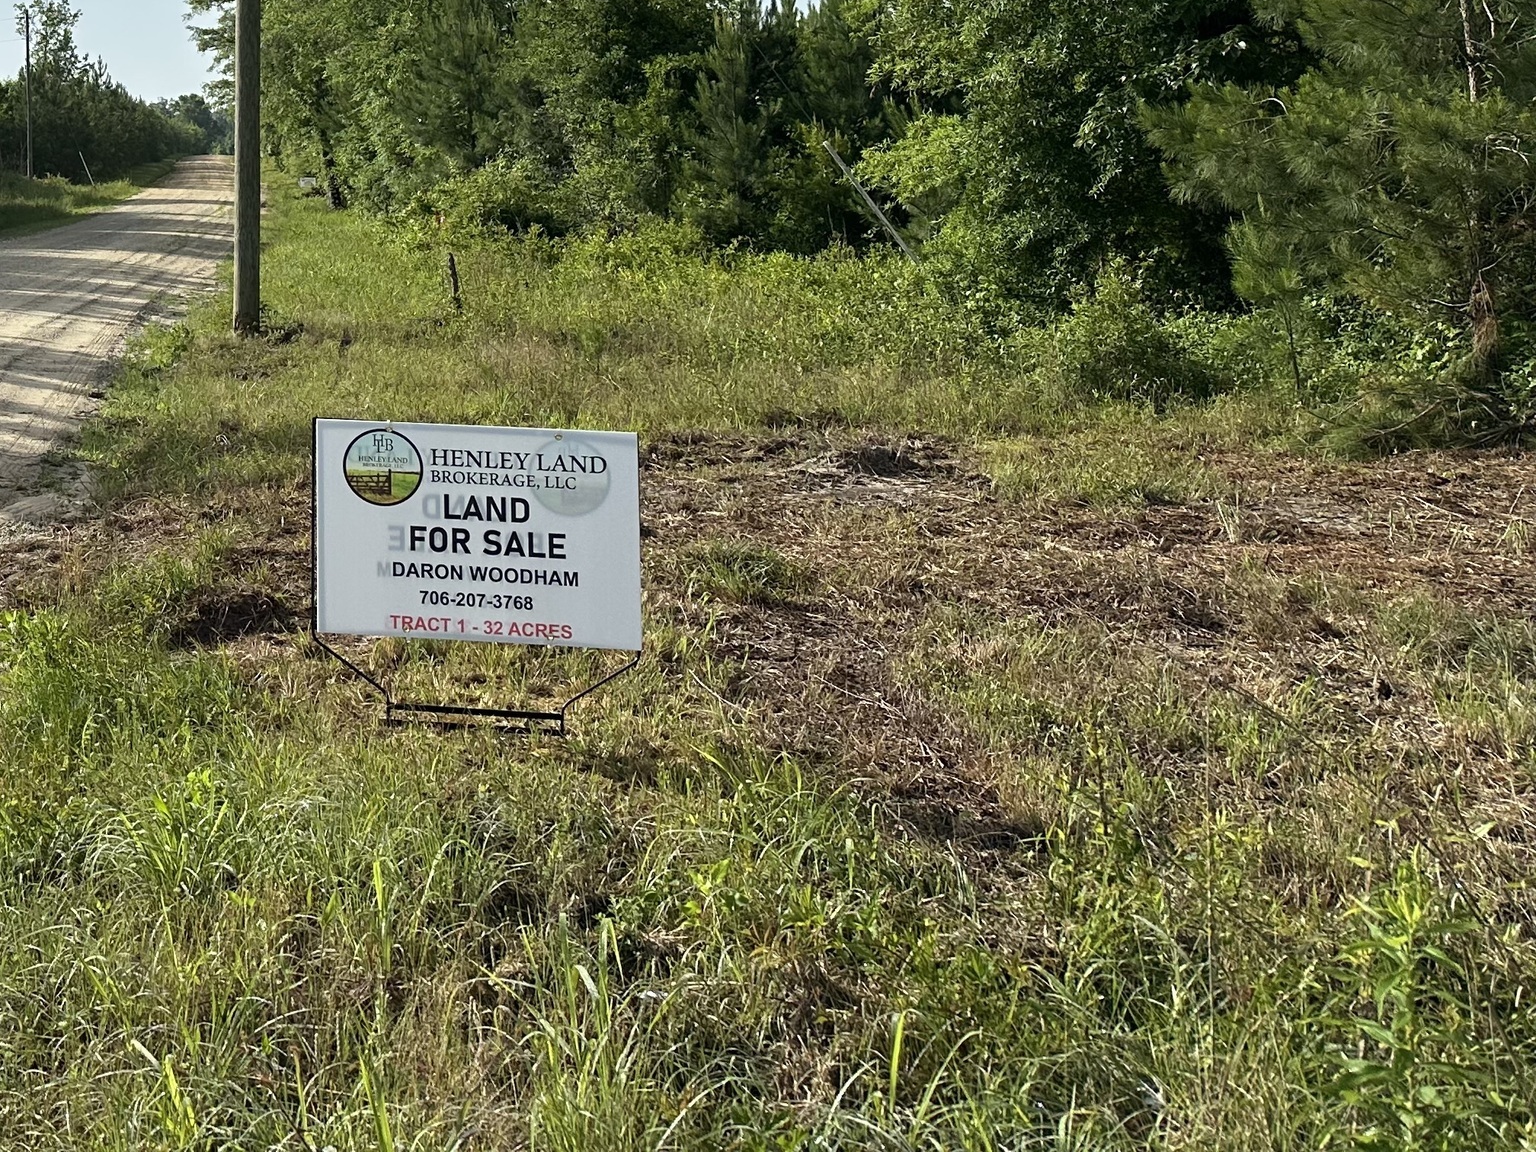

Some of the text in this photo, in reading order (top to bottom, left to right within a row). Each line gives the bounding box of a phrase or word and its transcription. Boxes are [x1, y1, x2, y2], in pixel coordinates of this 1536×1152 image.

[358, 455, 408, 464] HENLEY LAND
[431, 448, 608, 474] HENLEY LAND
[431, 470, 577, 490] BROKERAGE, LLC
[443, 494, 530, 523] LAND
[410, 526, 567, 559] FOR SALE
[392, 561, 579, 587] DARON WOODHAM
[419, 590, 533, 610] 706-207-3768
[390, 615, 451, 632] TRACT
[458, 618, 466, 633] 1
[483, 620, 503, 635] 32
[508, 622, 573, 639] ACRES
